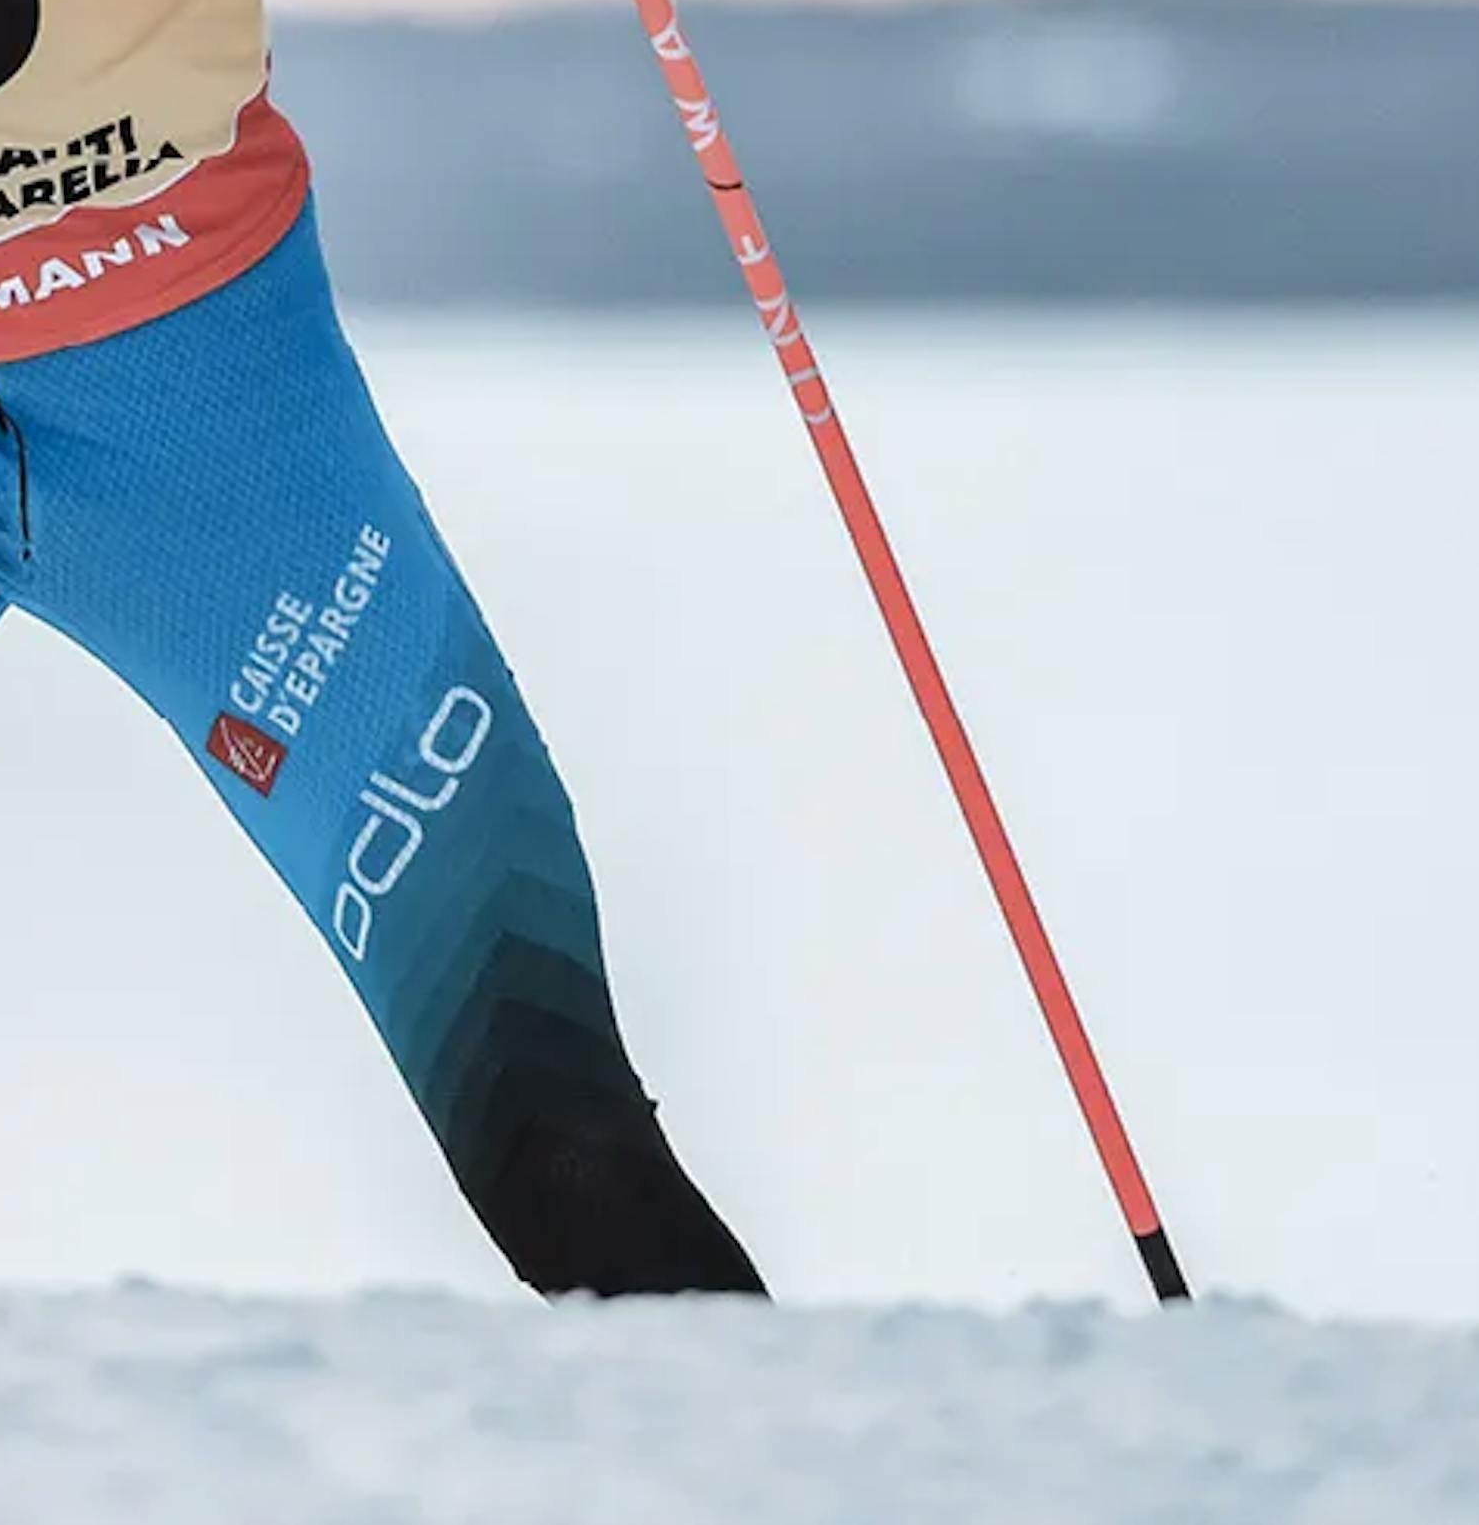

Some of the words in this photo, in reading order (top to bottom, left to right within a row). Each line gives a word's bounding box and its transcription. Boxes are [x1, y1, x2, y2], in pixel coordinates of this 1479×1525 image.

[229, 591, 314, 714] CAISSE
[266, 523, 392, 737] D'EPARGNE
[332, 685, 493, 962] odlo
